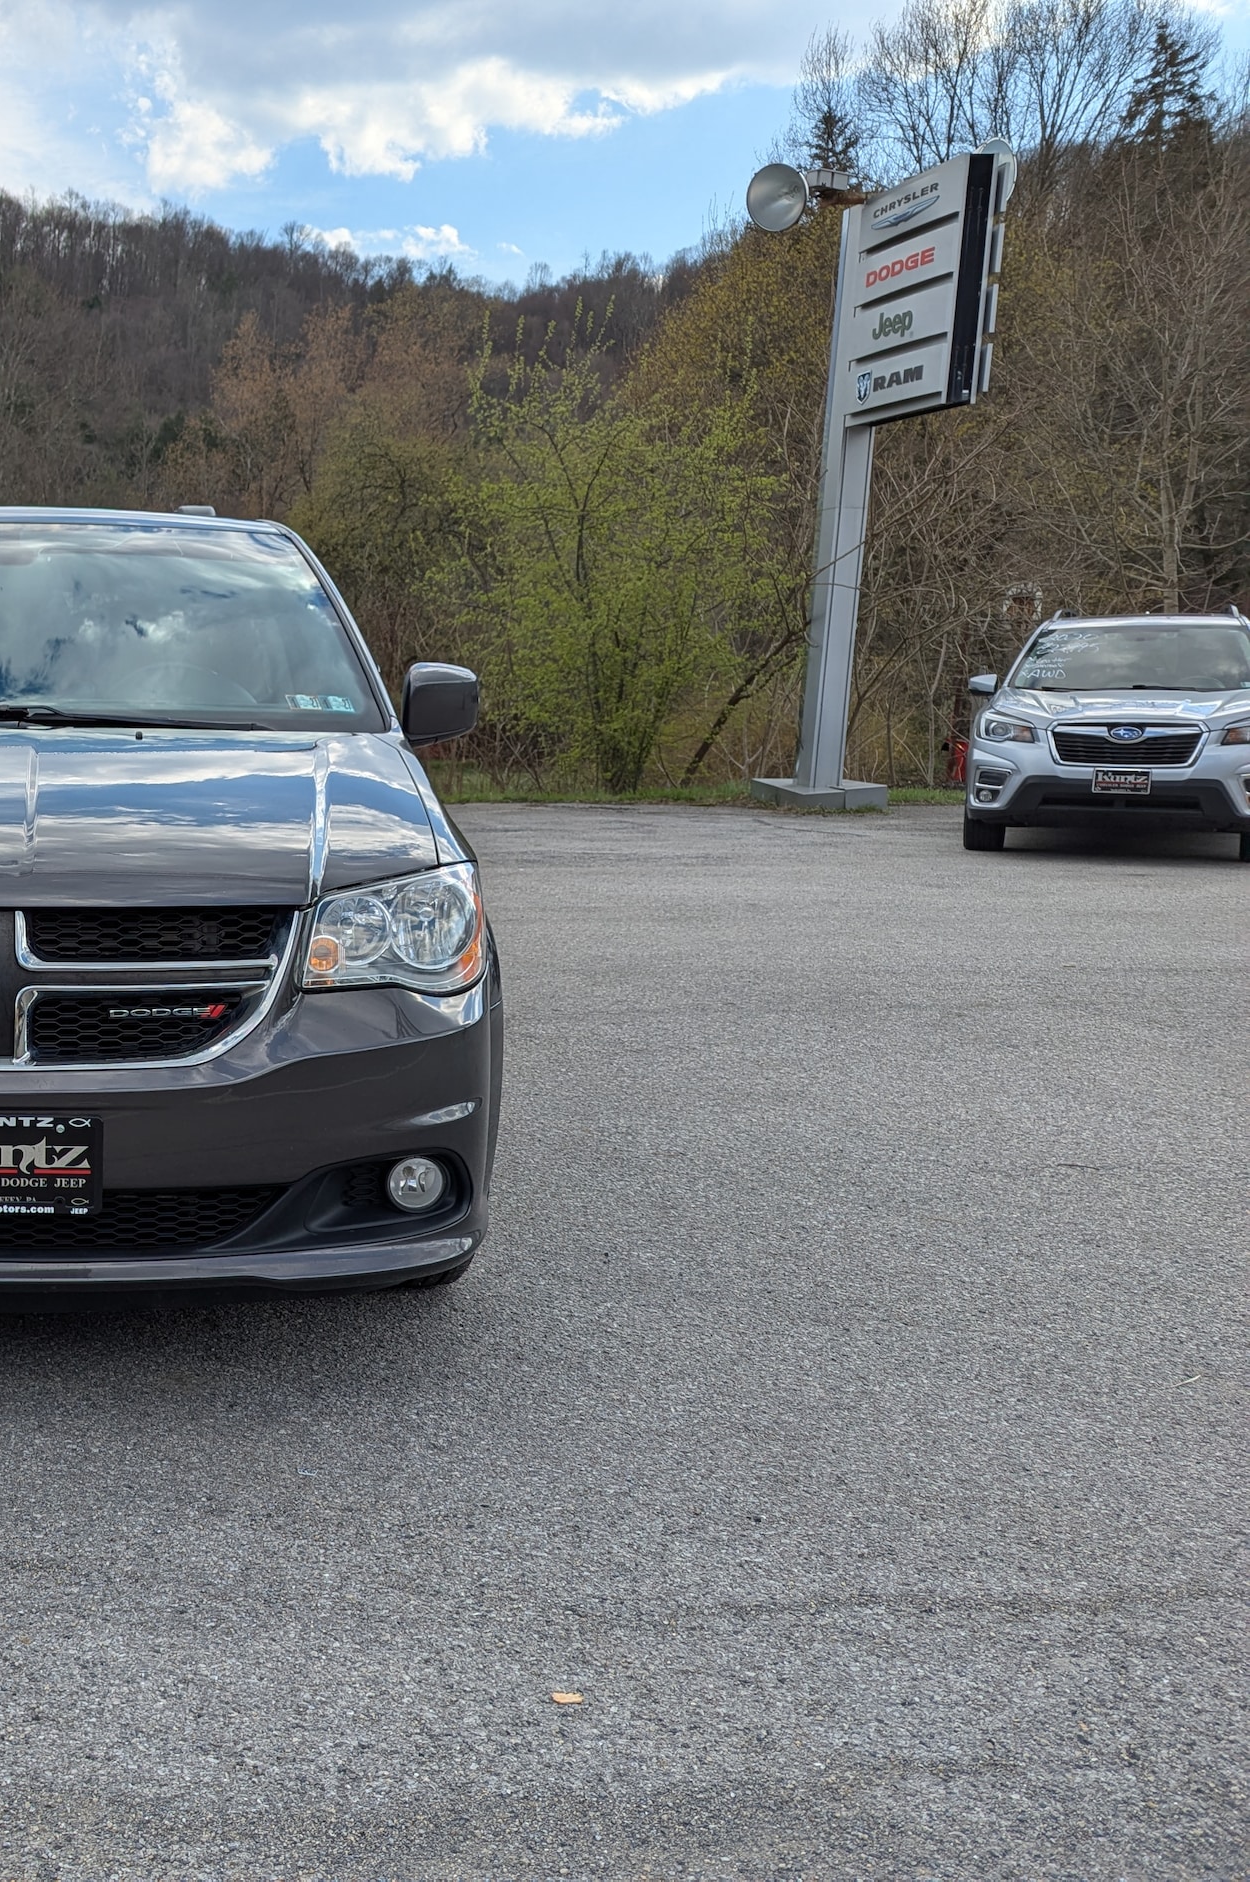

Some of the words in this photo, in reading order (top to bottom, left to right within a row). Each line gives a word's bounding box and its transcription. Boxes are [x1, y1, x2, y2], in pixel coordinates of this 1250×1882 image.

[873, 182, 939, 219] CHRYSLER
[865, 246, 936, 288] DODGE
[872, 309, 913, 340] Jeep
[872, 365, 924, 392] RAM
[1097, 772, 1148, 784] Kuntz
[109, 1008, 211, 1018] DODGE
[1, 1177, 48, 1187] DODGE
[54, 1177, 86, 1188] JEEP
